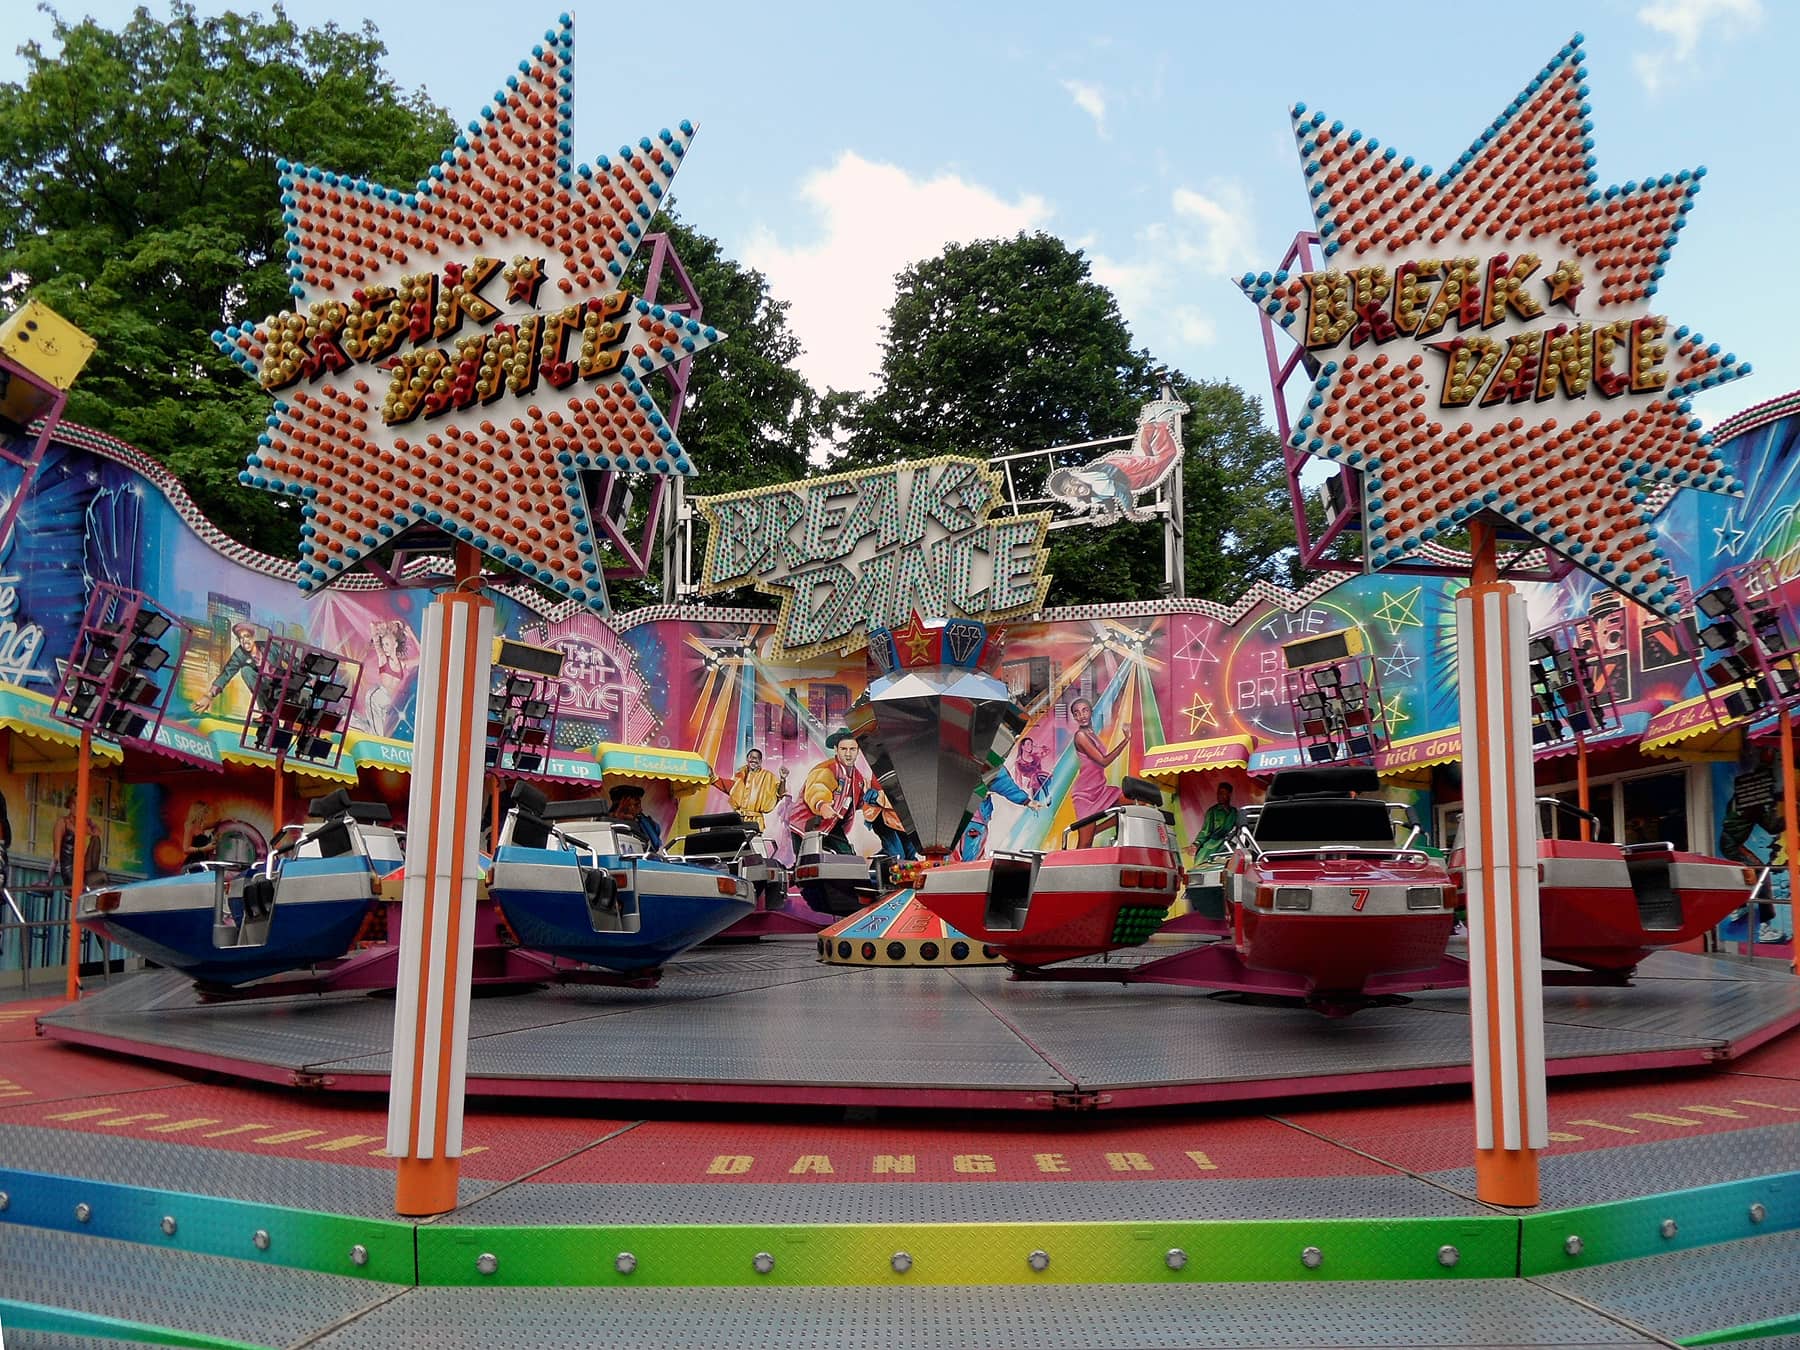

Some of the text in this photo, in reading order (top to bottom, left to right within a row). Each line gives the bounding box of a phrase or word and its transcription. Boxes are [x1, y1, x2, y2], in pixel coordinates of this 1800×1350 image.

[258, 255, 507, 391] BREAK
[1299, 251, 1547, 352] BREAK
[376, 289, 635, 427] DANCE
[1421, 314, 1669, 409] DANCE
[710, 462, 978, 585] BREAK
[767, 519, 1042, 650] DANCE
[1261, 609, 1328, 639] THE
[174, 733, 214, 759] speed
[1154, 746, 1228, 767] power flight
[1384, 748, 1417, 766] kick
[1350, 888, 1369, 912] 7
